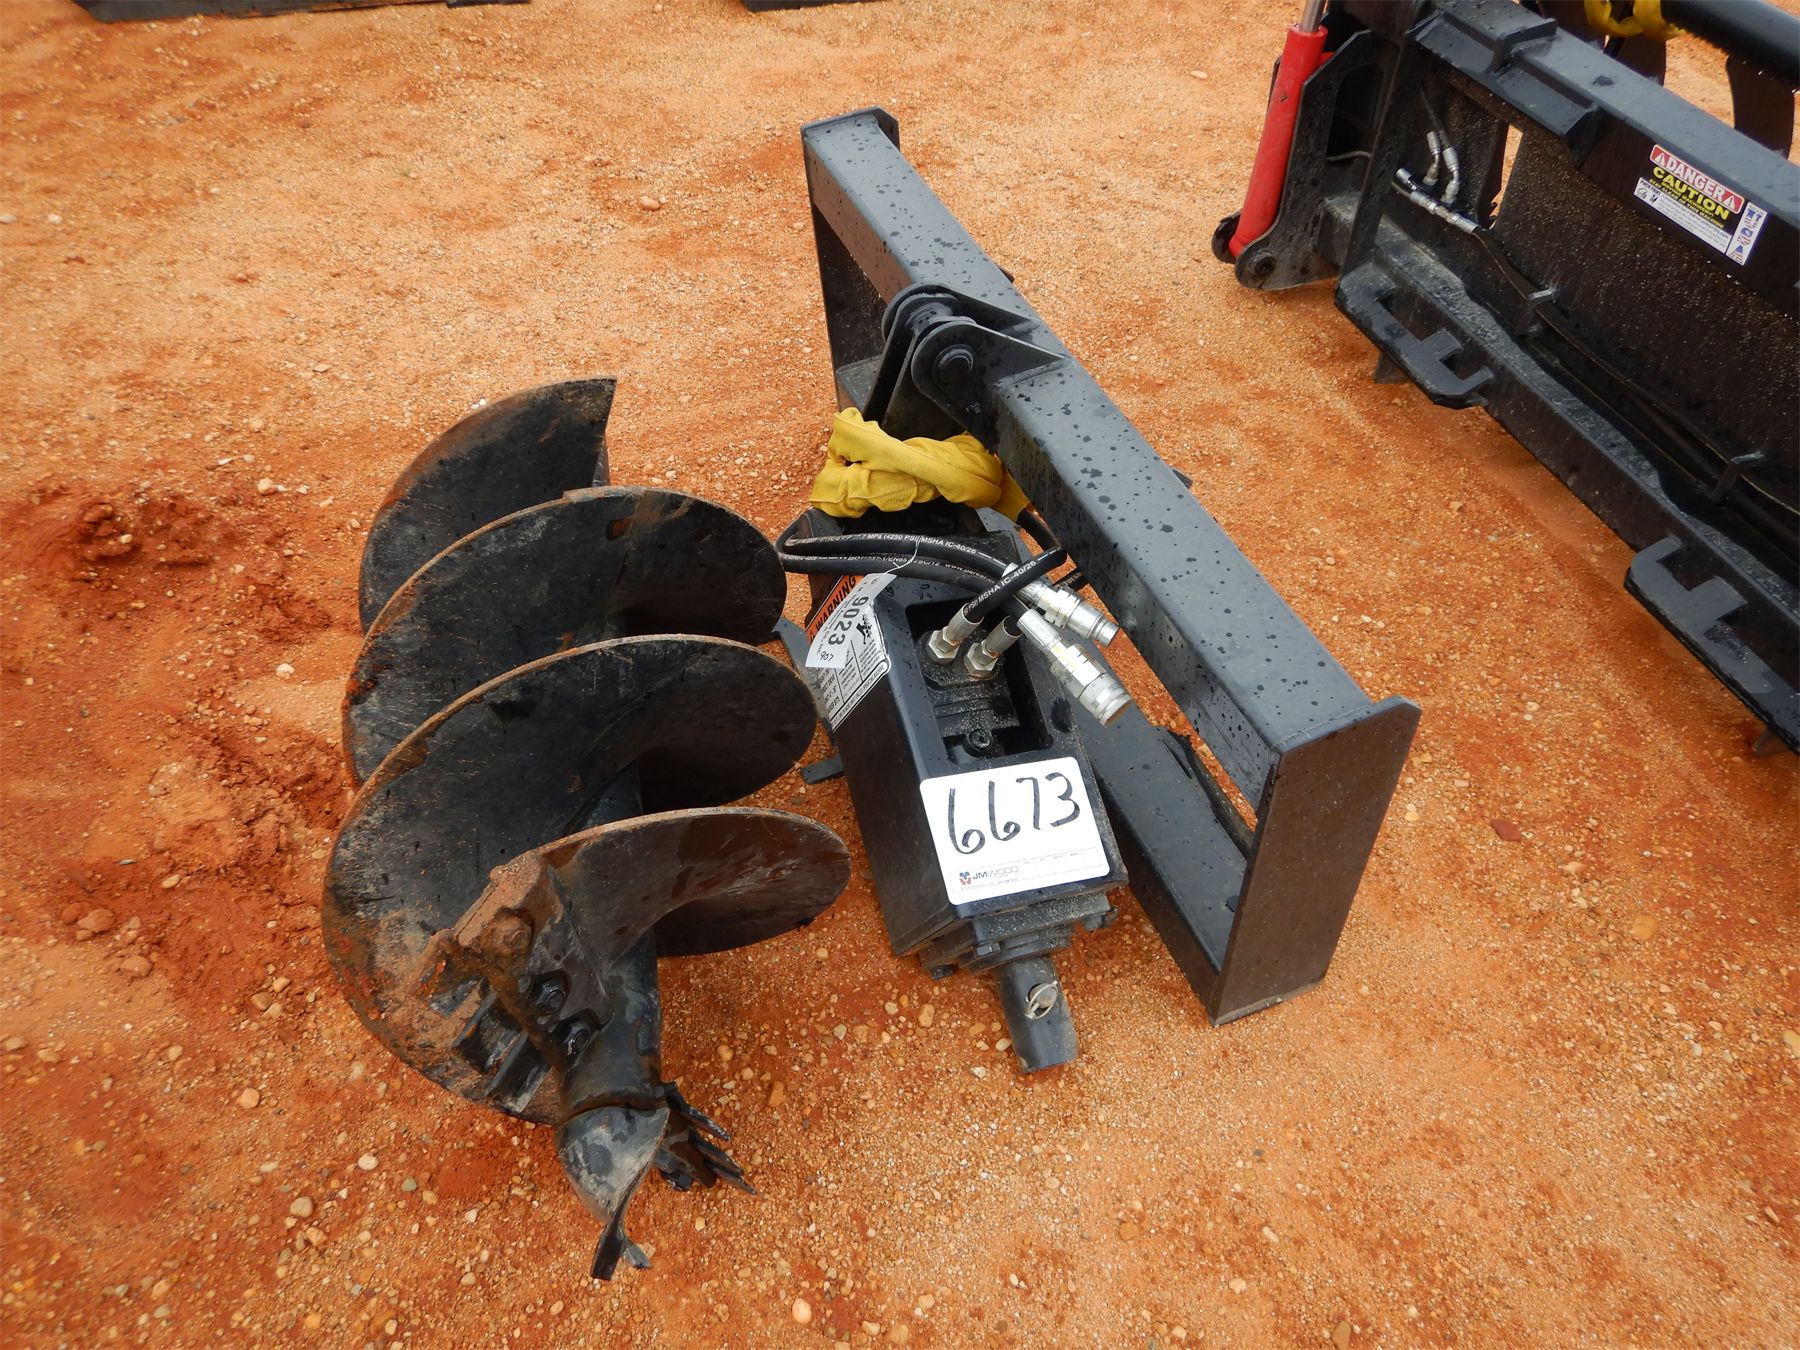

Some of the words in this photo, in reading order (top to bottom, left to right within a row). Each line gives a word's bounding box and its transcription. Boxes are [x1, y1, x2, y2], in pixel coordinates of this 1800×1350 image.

[1652, 166, 1729, 220] CAUTION
[1666, 156, 1725, 203] DANGER
[945, 540, 977, 555] IC-40/26
[815, 576, 857, 627] WARNING
[978, 585, 1001, 604] MSHA
[1001, 560, 1036, 587] IC-40/26
[828, 596, 869, 646] 9023
[948, 772, 1080, 854] 6673
